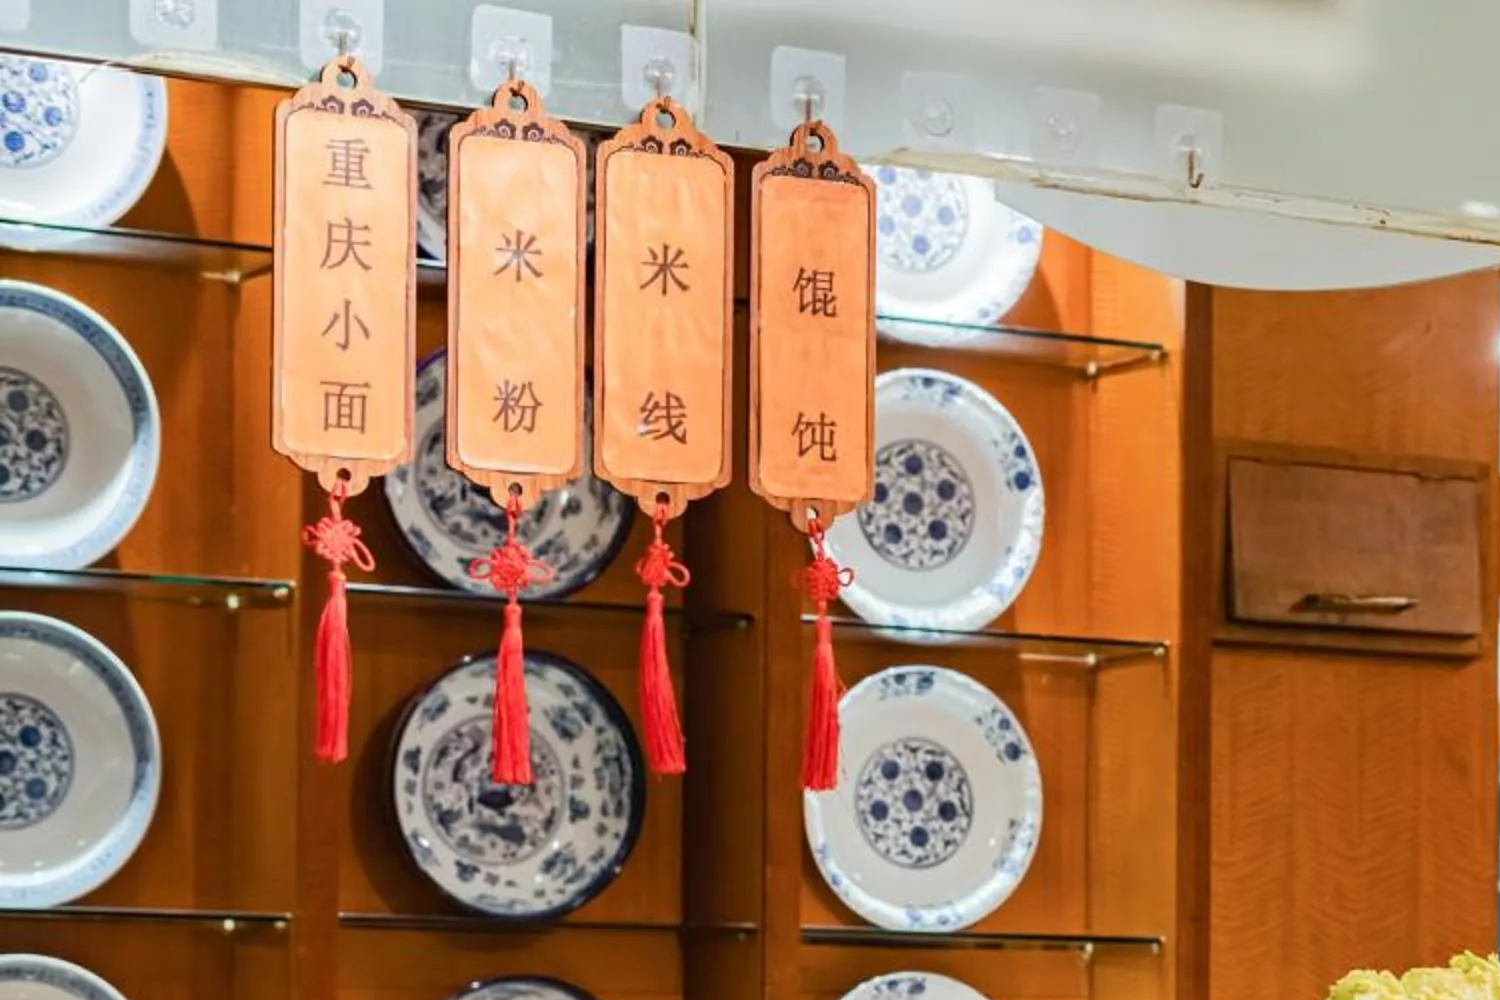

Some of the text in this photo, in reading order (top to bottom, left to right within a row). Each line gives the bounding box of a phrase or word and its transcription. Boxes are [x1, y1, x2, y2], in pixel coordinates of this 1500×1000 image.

[320, 137, 374, 434] 重庆小面
[492, 229, 544, 433] 米粉
[639, 242, 691, 445] 米线
[791, 266, 838, 463] 馄饨
